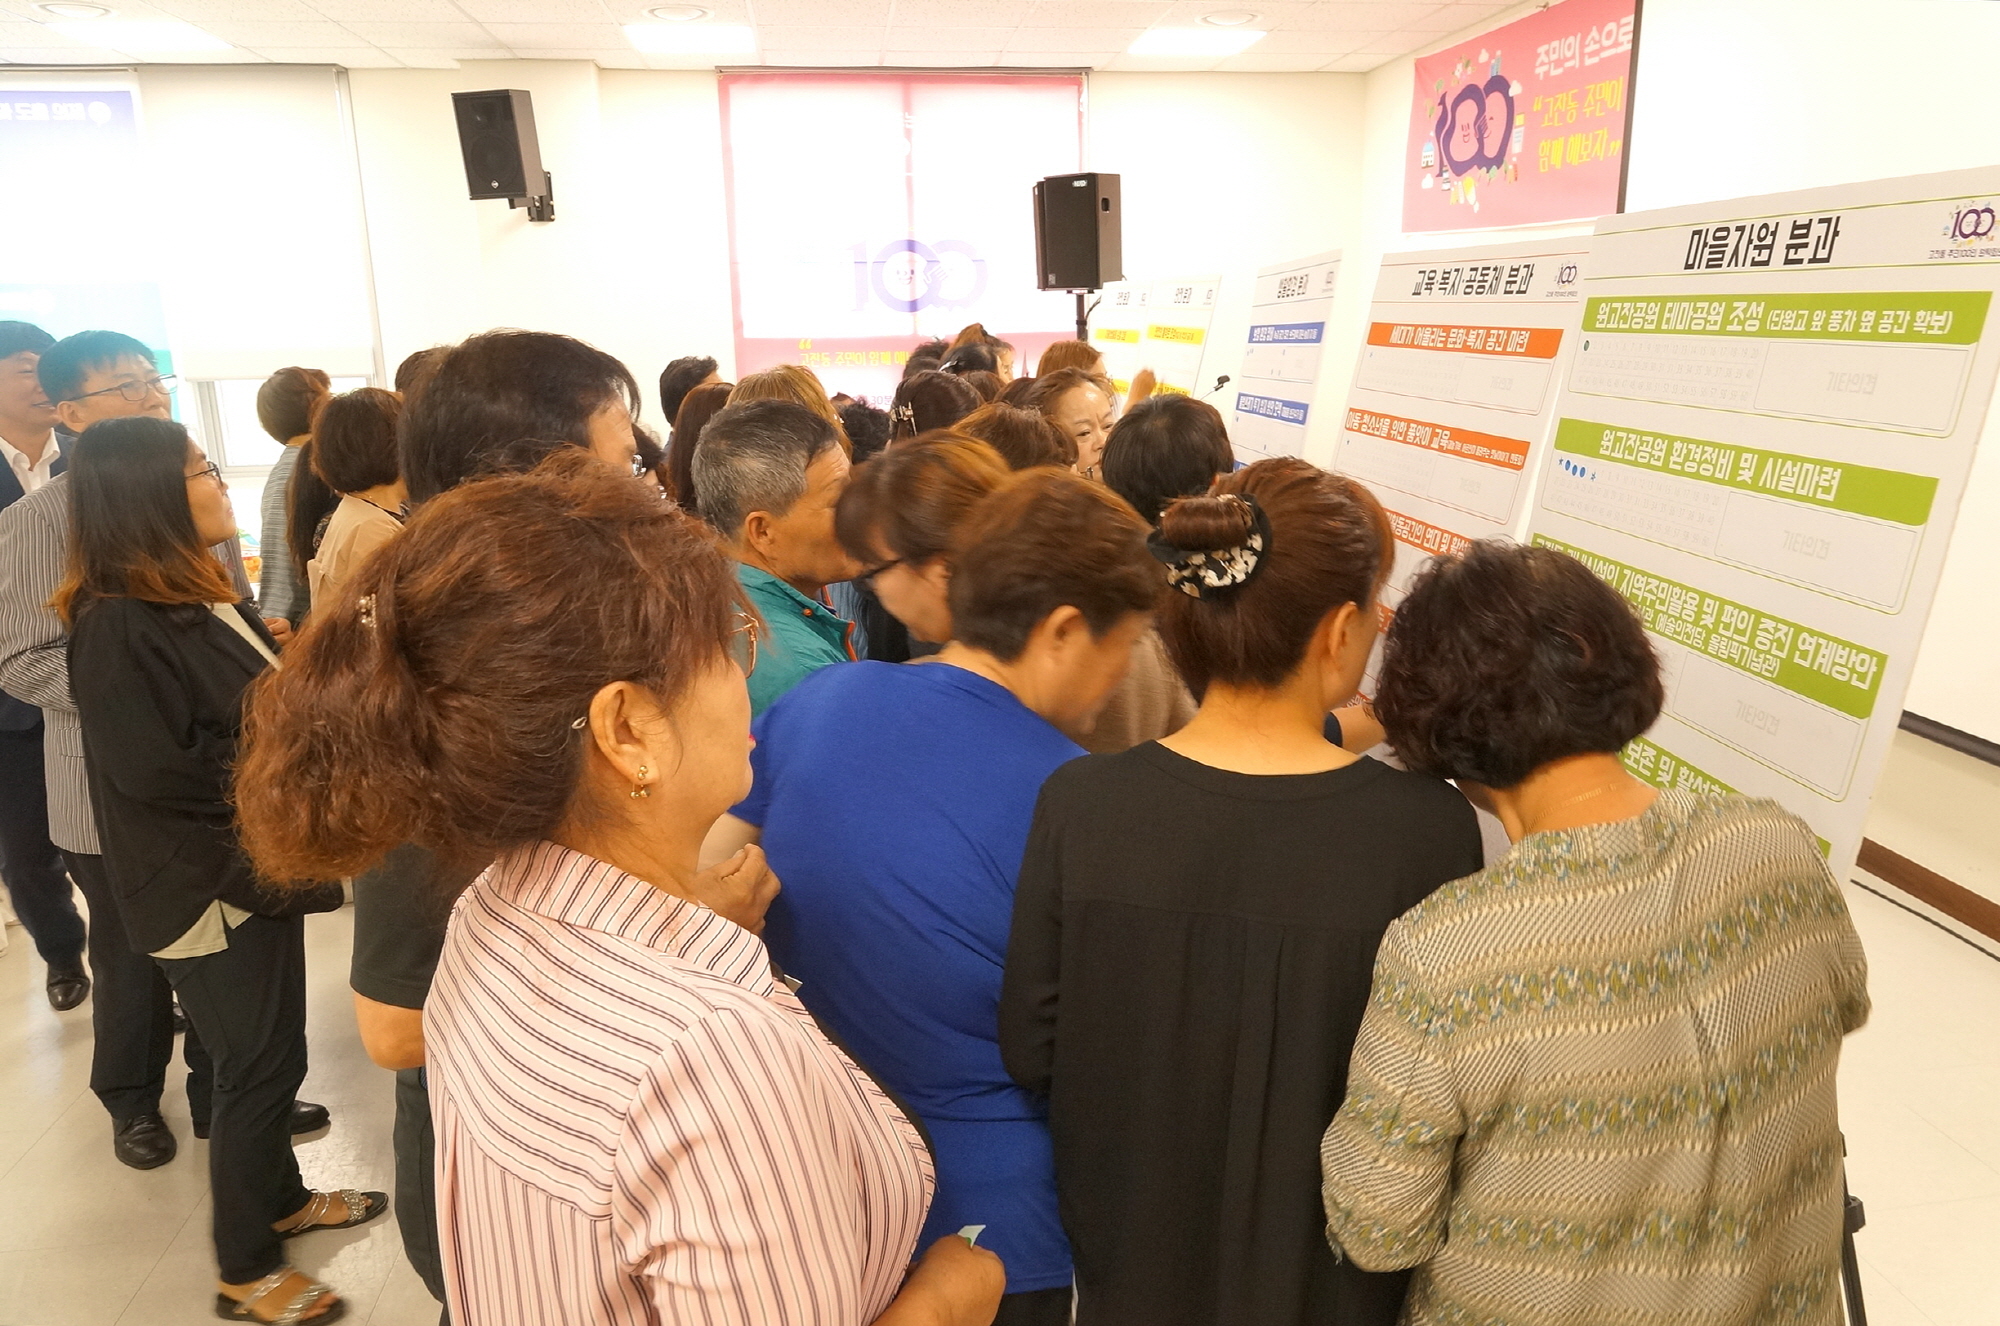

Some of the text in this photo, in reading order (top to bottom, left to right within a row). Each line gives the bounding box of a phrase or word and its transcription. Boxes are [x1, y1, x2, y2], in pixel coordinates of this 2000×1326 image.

[1534, 14, 1633, 80] 주민의 손으로
[1582, 75, 1624, 118] 주민이
[1538, 136, 1565, 173] 함께
[1683, 215, 1841, 271] 마을자원 분과
[1503, 262, 1535, 295] 분과
[1596, 301, 1954, 336] 원고잔공원 테마공원 조성 (단원고 앞 풍차 옆 공간 확보)
[834, 350, 867, 367] 주민이
[1413, 327, 1447, 350] 어울리는
[1485, 329, 1509, 353] 공간
[1506, 330, 1531, 354] 마련
[1390, 420, 1408, 442] 위한
[1599, 429, 1669, 468] 원고잔공원
[1668, 440, 1736, 481] 환경정비
[1736, 452, 1759, 486] 및
[1758, 456, 1843, 502] 시설마련
[1618, 568, 1700, 622] 지역주민활용
[1699, 597, 1720, 630] 및
[1718, 603, 1755, 644] 편의
[1753, 617, 1795, 659] 증진
[1793, 631, 1879, 691] 연계방안
[1623, 740, 1658, 778] 보존
[1655, 754, 1676, 789] 및
